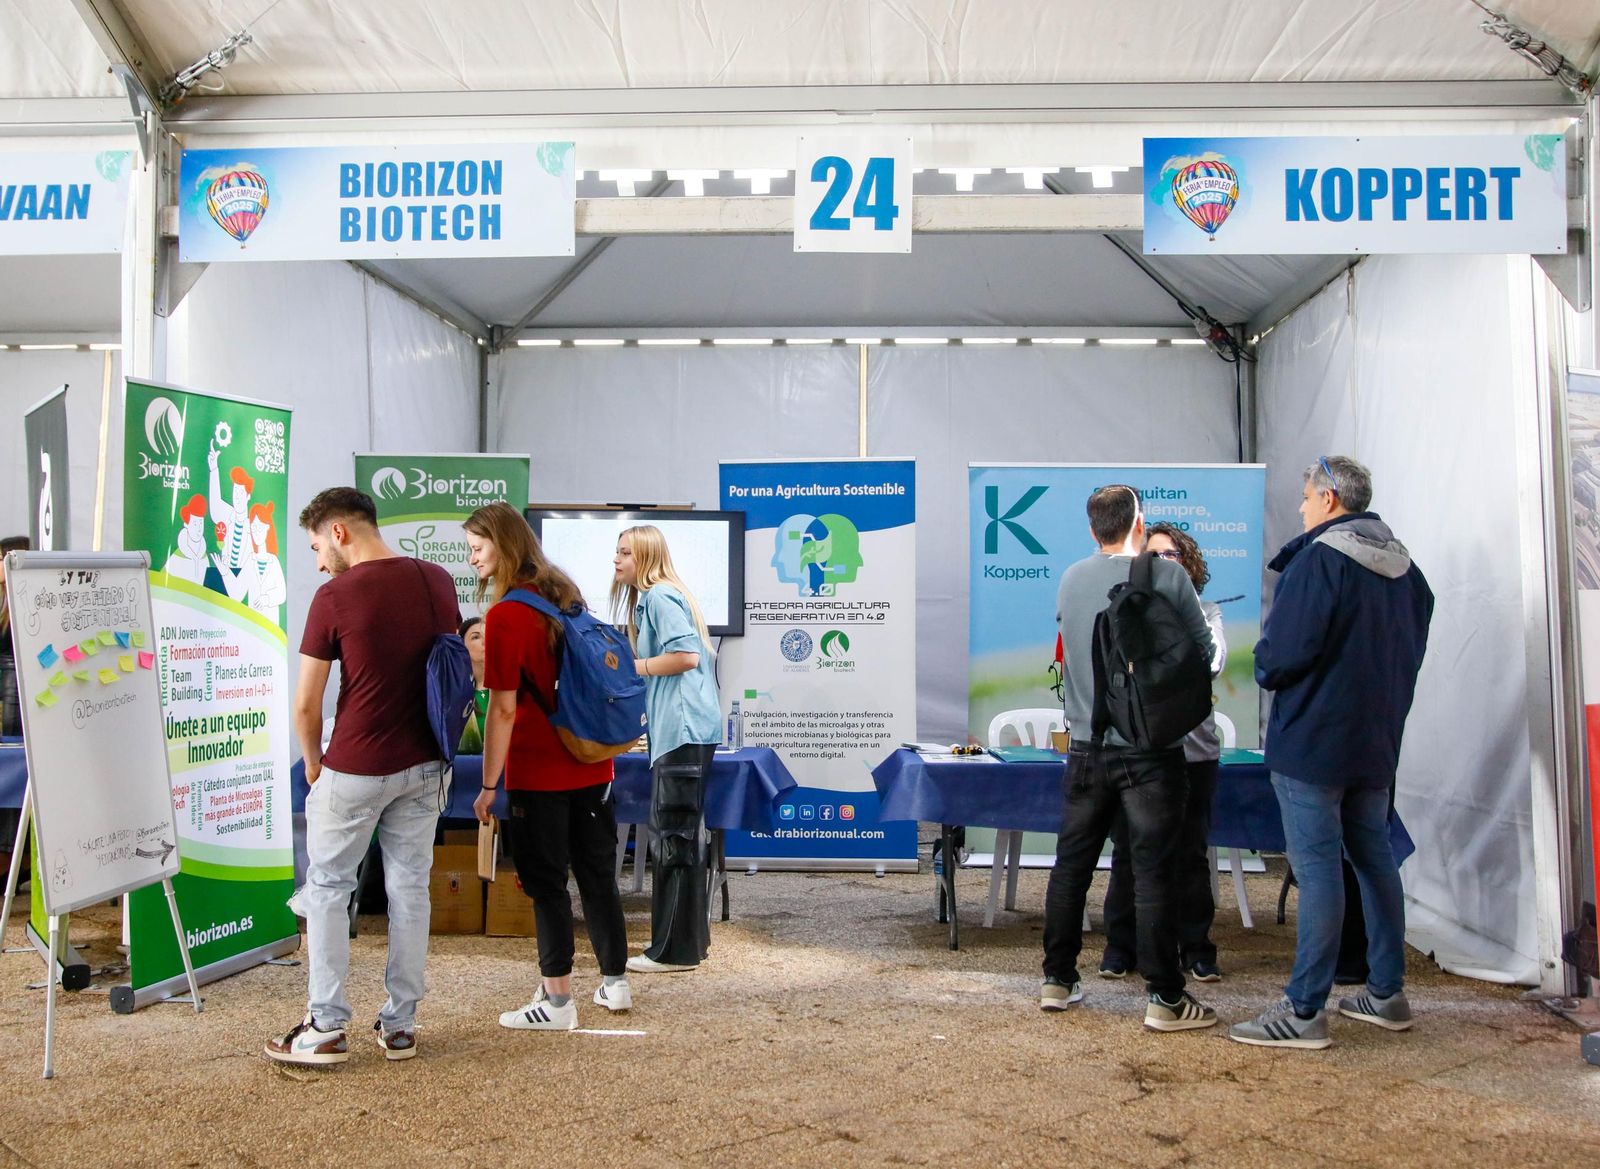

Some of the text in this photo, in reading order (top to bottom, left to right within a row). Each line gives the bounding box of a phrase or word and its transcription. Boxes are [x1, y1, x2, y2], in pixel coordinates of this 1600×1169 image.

[340, 160, 502, 198] BIORIZON
[1183, 181, 1201, 195] FERIA
[1204, 179, 1231, 191] EMPLEO
[236, 188, 262, 199] EMPLEO
[809, 156, 899, 230] 24
[1192, 192, 1223, 205] 2025
[1285, 166, 1521, 221] KOPPERT
[225, 201, 255, 212] 2025
[340, 204, 501, 242] BIOTECH
[409, 467, 507, 499] Biorizon
[729, 482, 905, 499] Por una Agricultura Sostenible
[1193, 521, 1248, 532] nunca
[1201, 546, 1248, 558] nciona
[984, 565, 1050, 581] Koppert
[805, 601, 890, 610] AGRICULTURA
[749, 613, 845, 621] REGENERATIVA
[160, 626, 227, 640] ADN Joven Proyección
[170, 642, 239, 661] Formación continua
[816, 656, 855, 670] Biorizon
[171, 669, 192, 683] Team
[215, 663, 273, 680] Planes de Carrera
[204, 661, 212, 701] Ciencia
[172, 685, 203, 702] Building
[215, 682, 273, 701] Inversión en I+D+i
[743, 711, 789, 719] Divulgación,
[790, 711, 838, 719] investigación
[166, 707, 266, 740] Únete a un equipo
[820, 721, 859, 730] microalgas
[836, 731, 873, 739] biológicas
[188, 735, 244, 764] Innovador
[771, 741, 811, 749] agricultura
[812, 741, 858, 749] regenerativa
[820, 751, 846, 759] digital.
[203, 769, 274, 792] Cátedra conjunta con UAL
[172, 784, 190, 799] ología
[210, 788, 263, 807] Planta de Microalgas
[205, 799, 263, 822] más grande de EUROPA
[265, 785, 274, 840] Innovación
[216, 815, 263, 835] Sostenibilidad
[750, 828, 885, 839] cadrabiorizonual.com
[186, 915, 253, 949] biorizon.es
